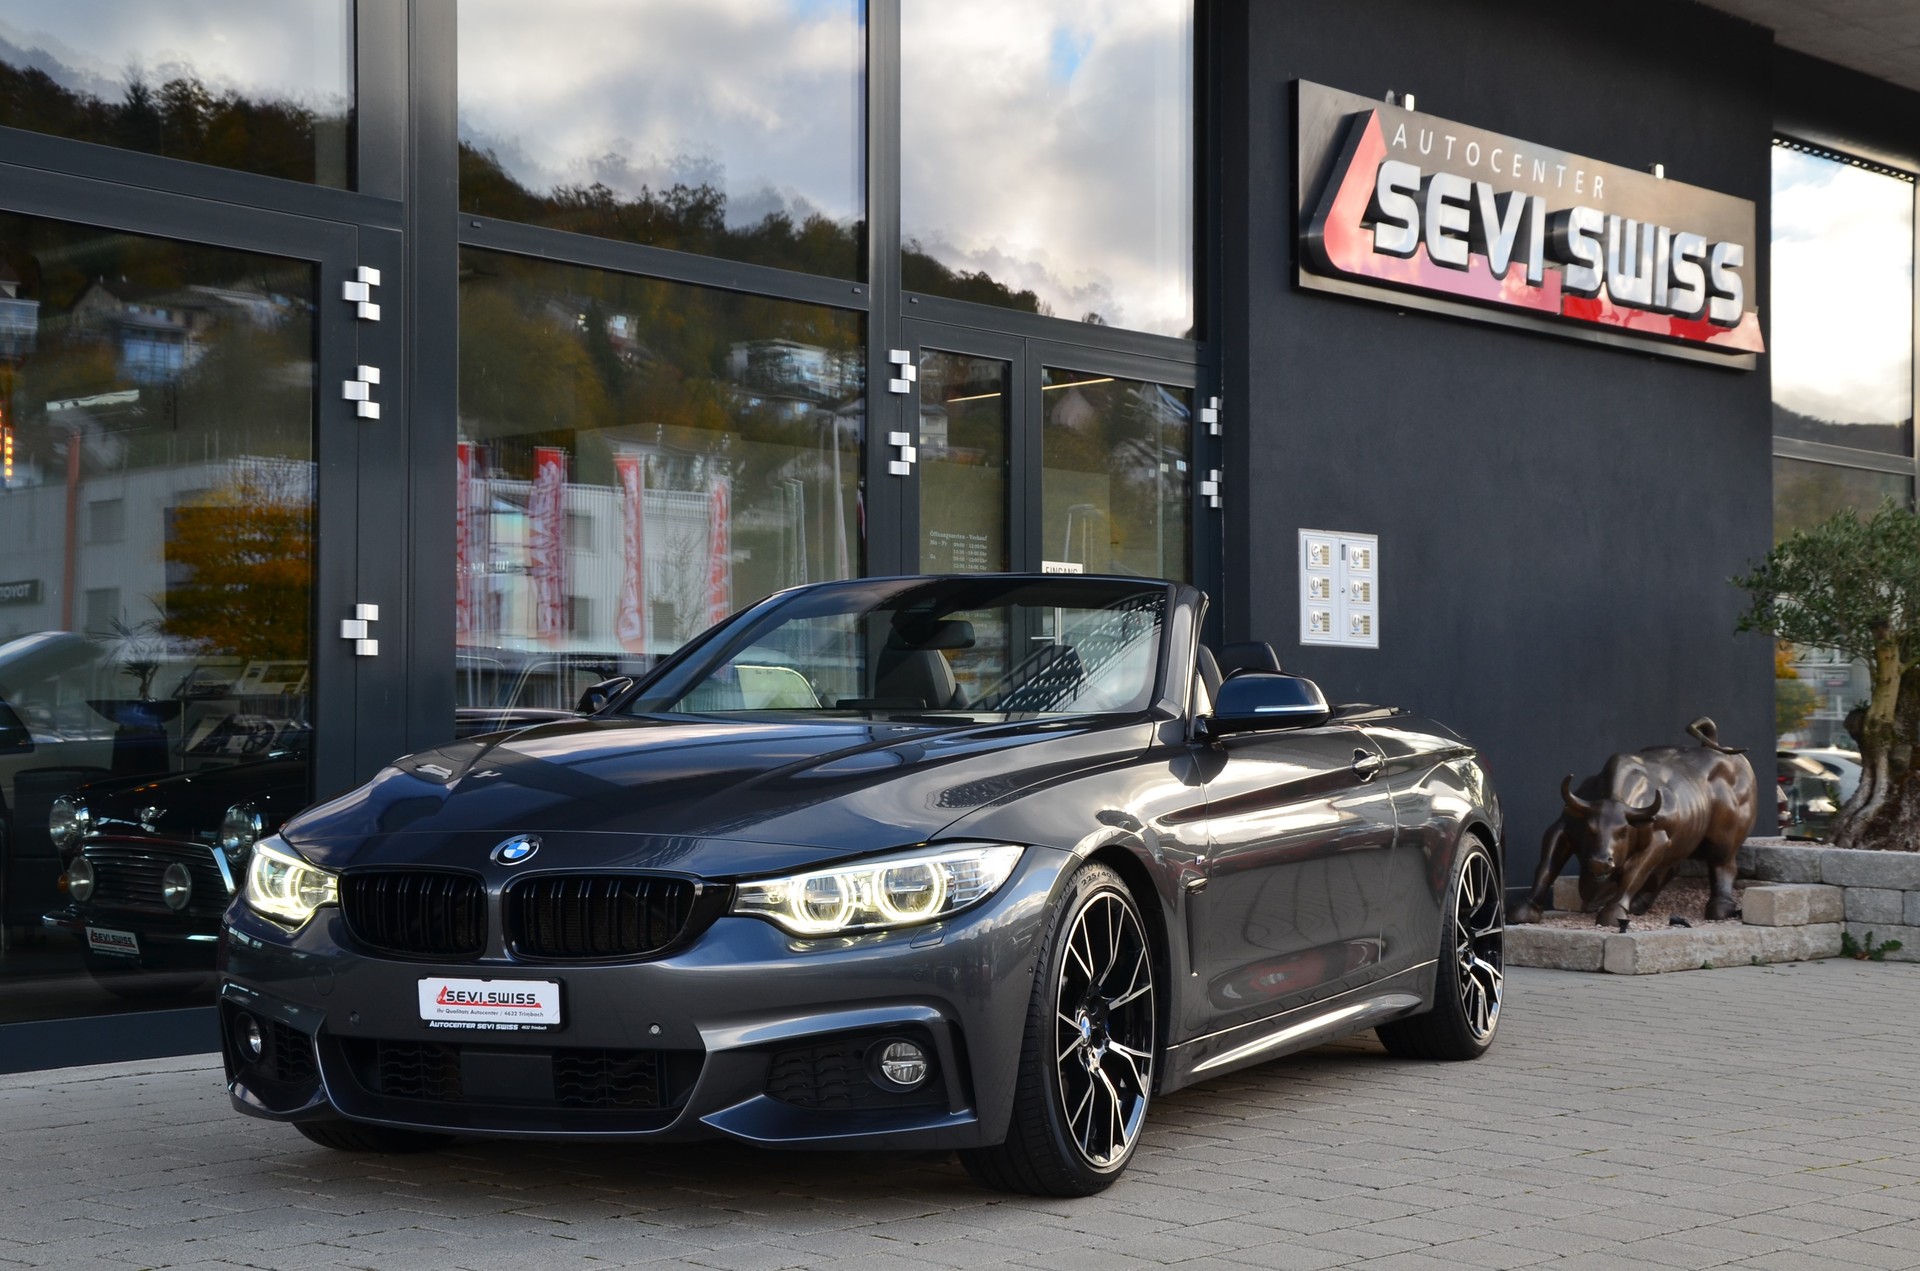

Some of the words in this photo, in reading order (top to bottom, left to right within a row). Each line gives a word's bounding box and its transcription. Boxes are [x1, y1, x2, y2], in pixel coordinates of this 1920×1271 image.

[1392, 122, 1605, 199] AUTOCENTER
[1373, 159, 1547, 286] SEVI
[1562, 205, 1746, 328] SWISS
[446, 990, 483, 1003] SEVI
[487, 992, 536, 1005] SWISS
[477, 1022, 495, 1030] SEVI
